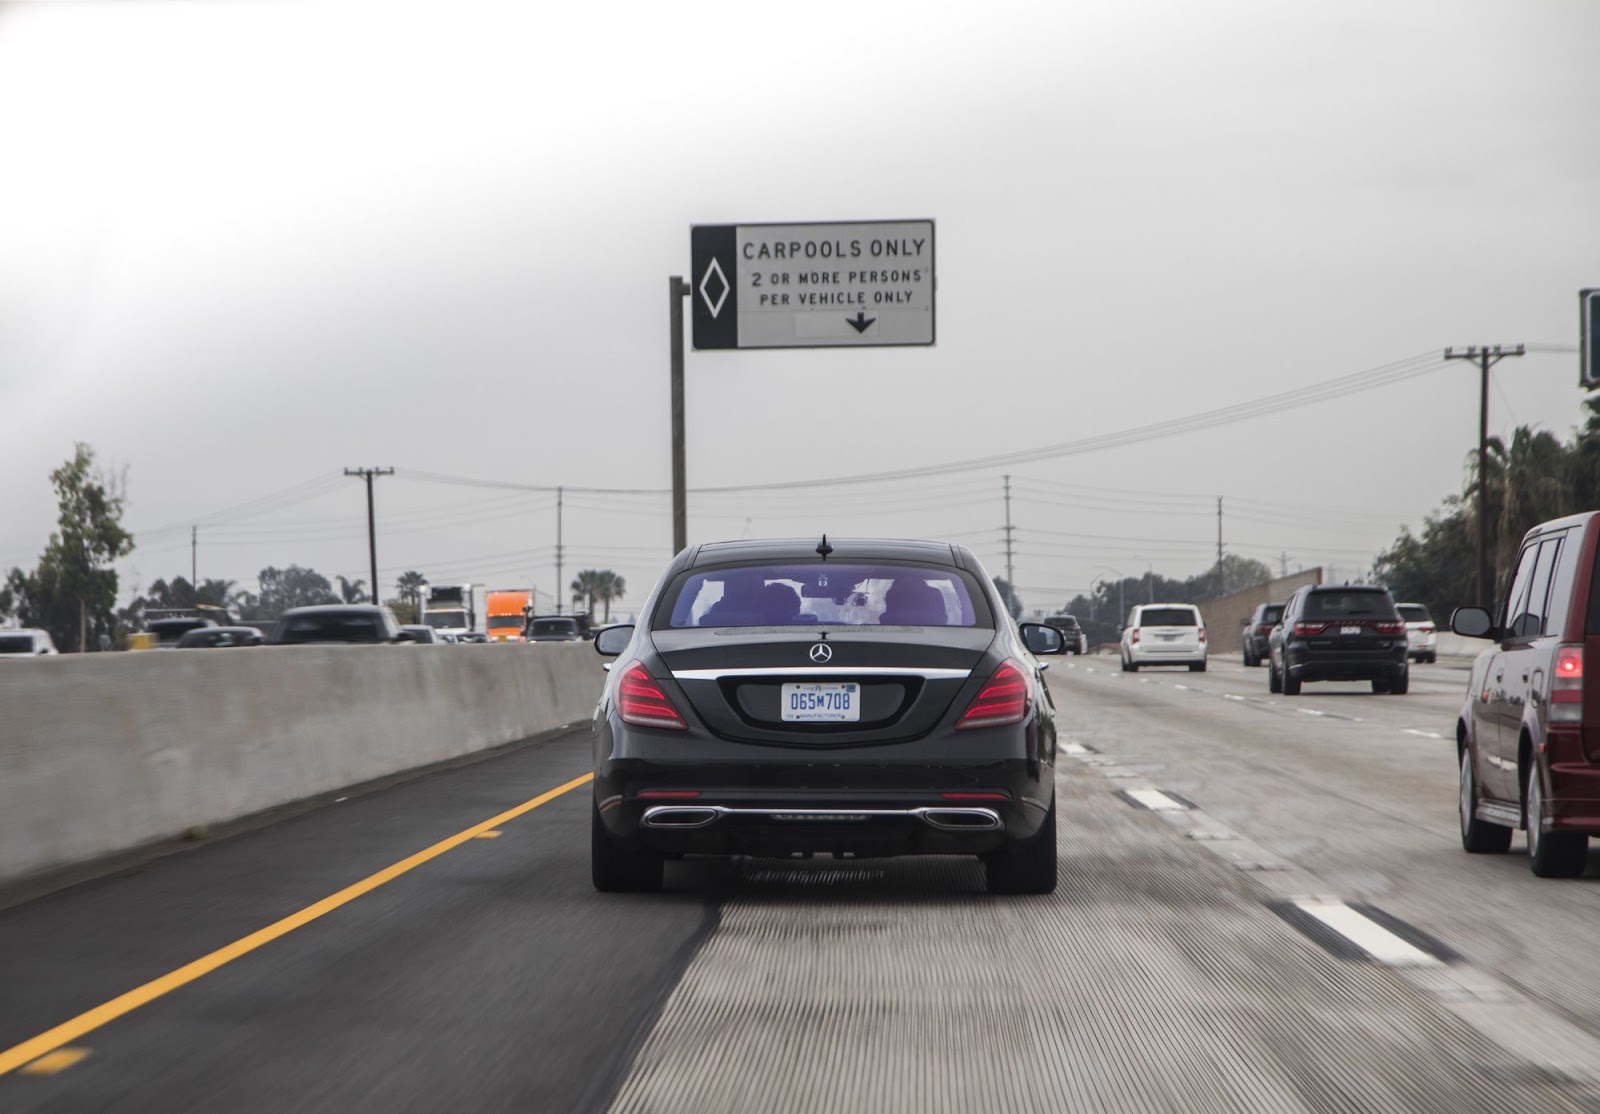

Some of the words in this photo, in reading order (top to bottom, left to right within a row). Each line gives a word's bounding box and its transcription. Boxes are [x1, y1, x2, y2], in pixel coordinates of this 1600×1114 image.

[743, 240, 861, 260] CARPOOLS
[870, 238, 925, 257] ONLY
[751, 273, 762, 287] 2
[771, 272, 790, 285] OR
[799, 271, 840, 284] MORE
[849, 269, 921, 283] PERSONS
[760, 293, 790, 305] PER
[799, 291, 865, 305] VEHICLE
[874, 290, 913, 304] ONLY
[791, 693, 850, 710] 065M708
